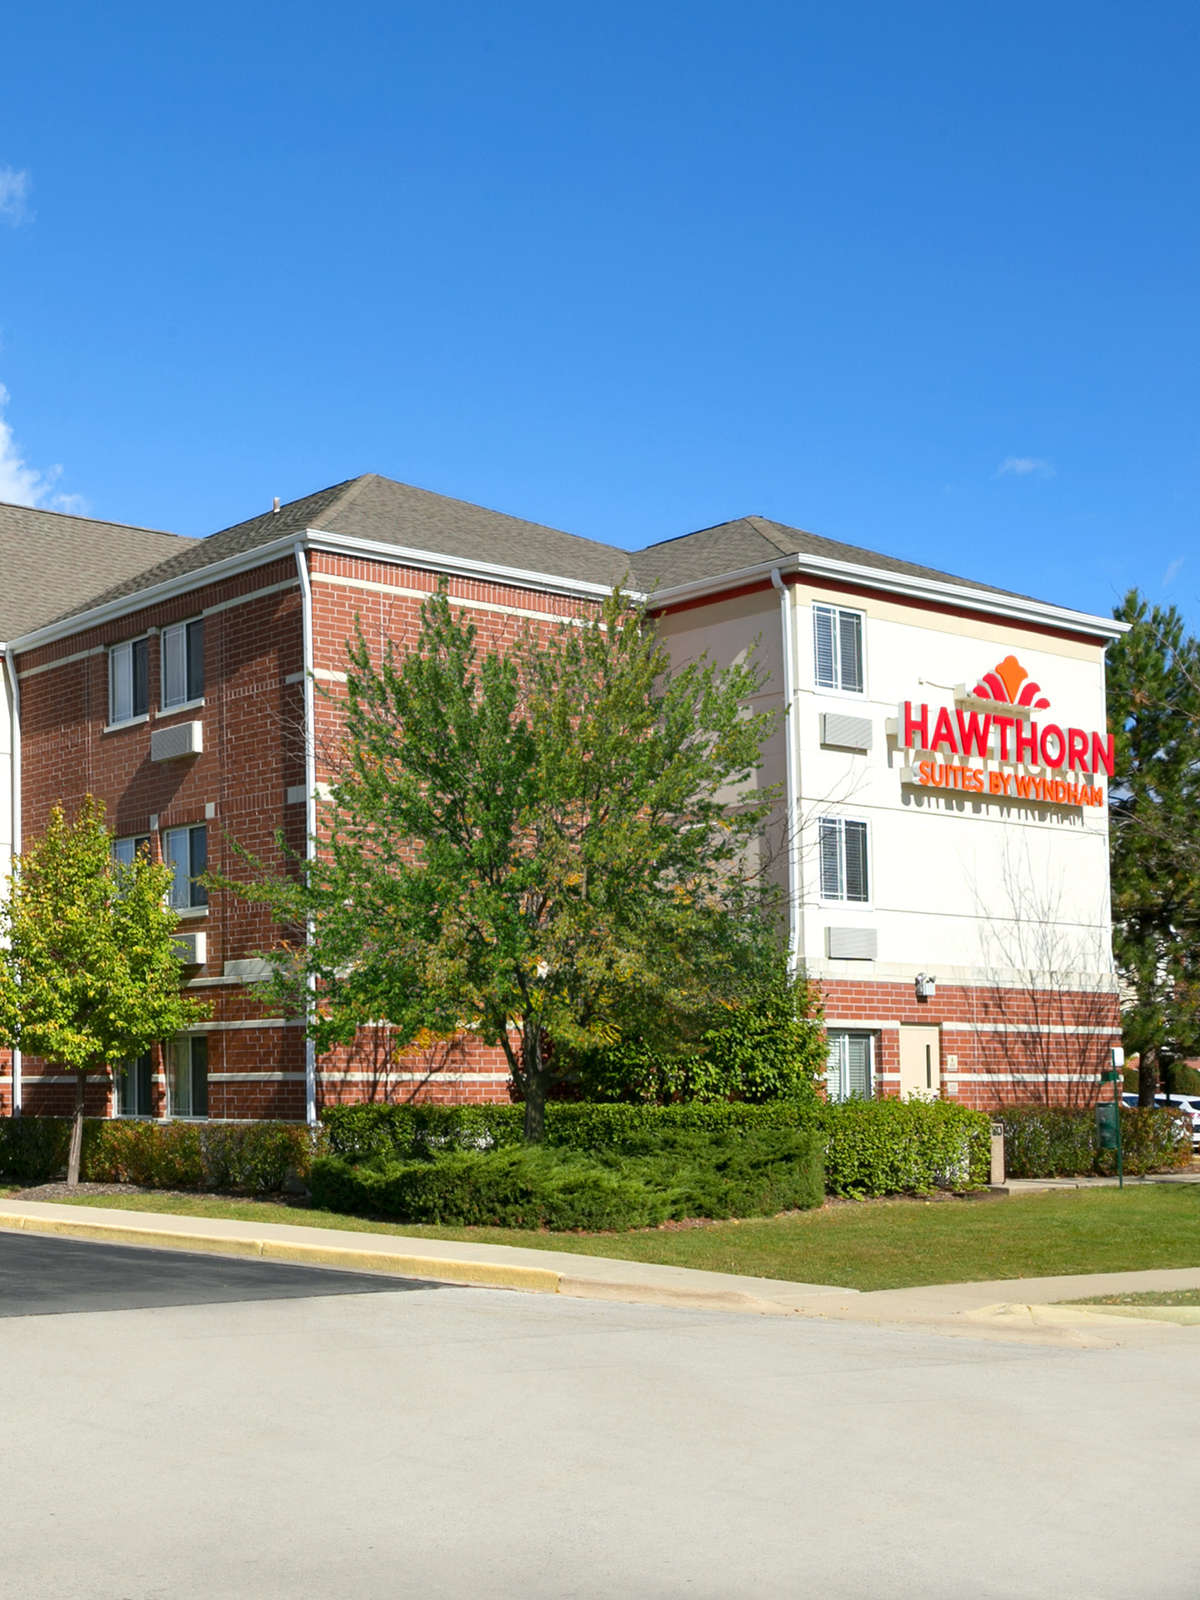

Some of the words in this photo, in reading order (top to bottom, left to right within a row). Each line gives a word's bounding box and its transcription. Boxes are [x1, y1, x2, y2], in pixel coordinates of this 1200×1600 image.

[904, 701, 1115, 777] HAWTHORN
[918, 760, 985, 793] SUITES
[989, 771, 1012, 796] BY
[1014, 774, 1104, 807] WYNDHAM
